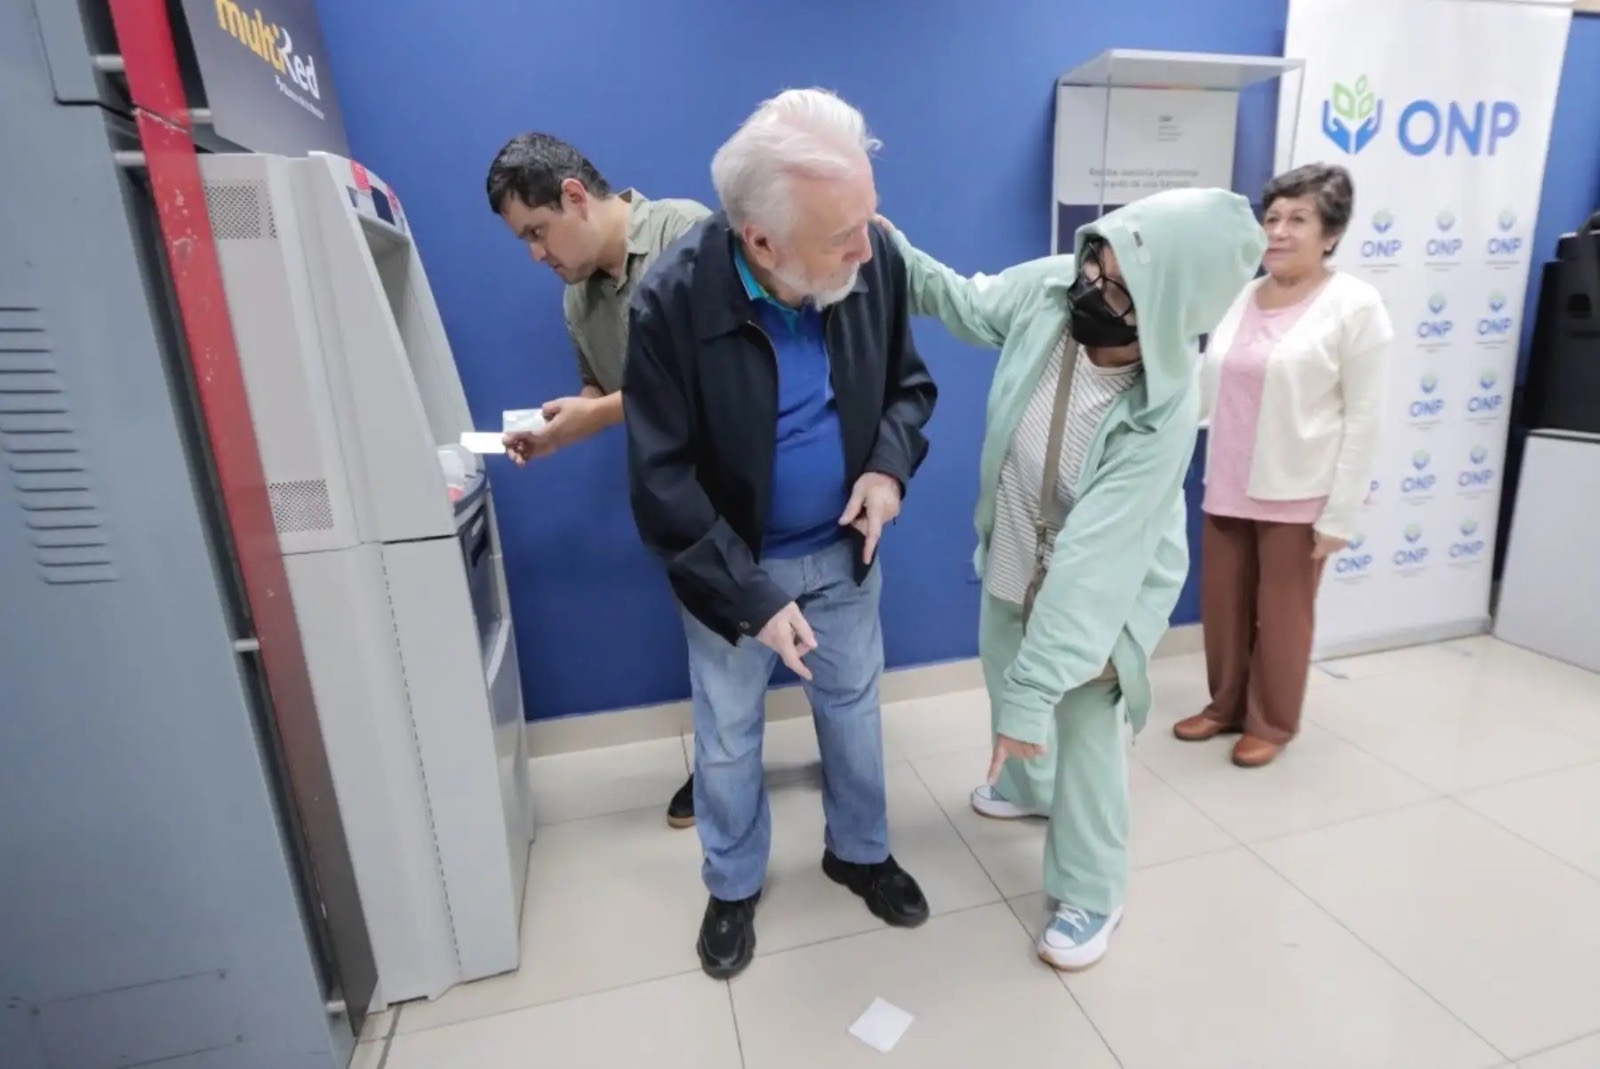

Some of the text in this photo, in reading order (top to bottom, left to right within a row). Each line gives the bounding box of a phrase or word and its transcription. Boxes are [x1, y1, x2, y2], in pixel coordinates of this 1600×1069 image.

[1397, 99, 1520, 156] ONP
[1361, 239, 1402, 258] ONP
[1426, 239, 1463, 257] ONP
[1488, 237, 1523, 255] ONP
[1418, 320, 1453, 338] ONP
[1477, 317, 1513, 336] ONP
[1410, 399, 1444, 418] ONP
[1467, 394, 1503, 413] ONP
[1402, 474, 1436, 493] ONP
[1458, 469, 1494, 487] ONP
[1393, 547, 1429, 566] ONP
[1449, 540, 1485, 558] ONP
[1335, 554, 1373, 574] ONP
